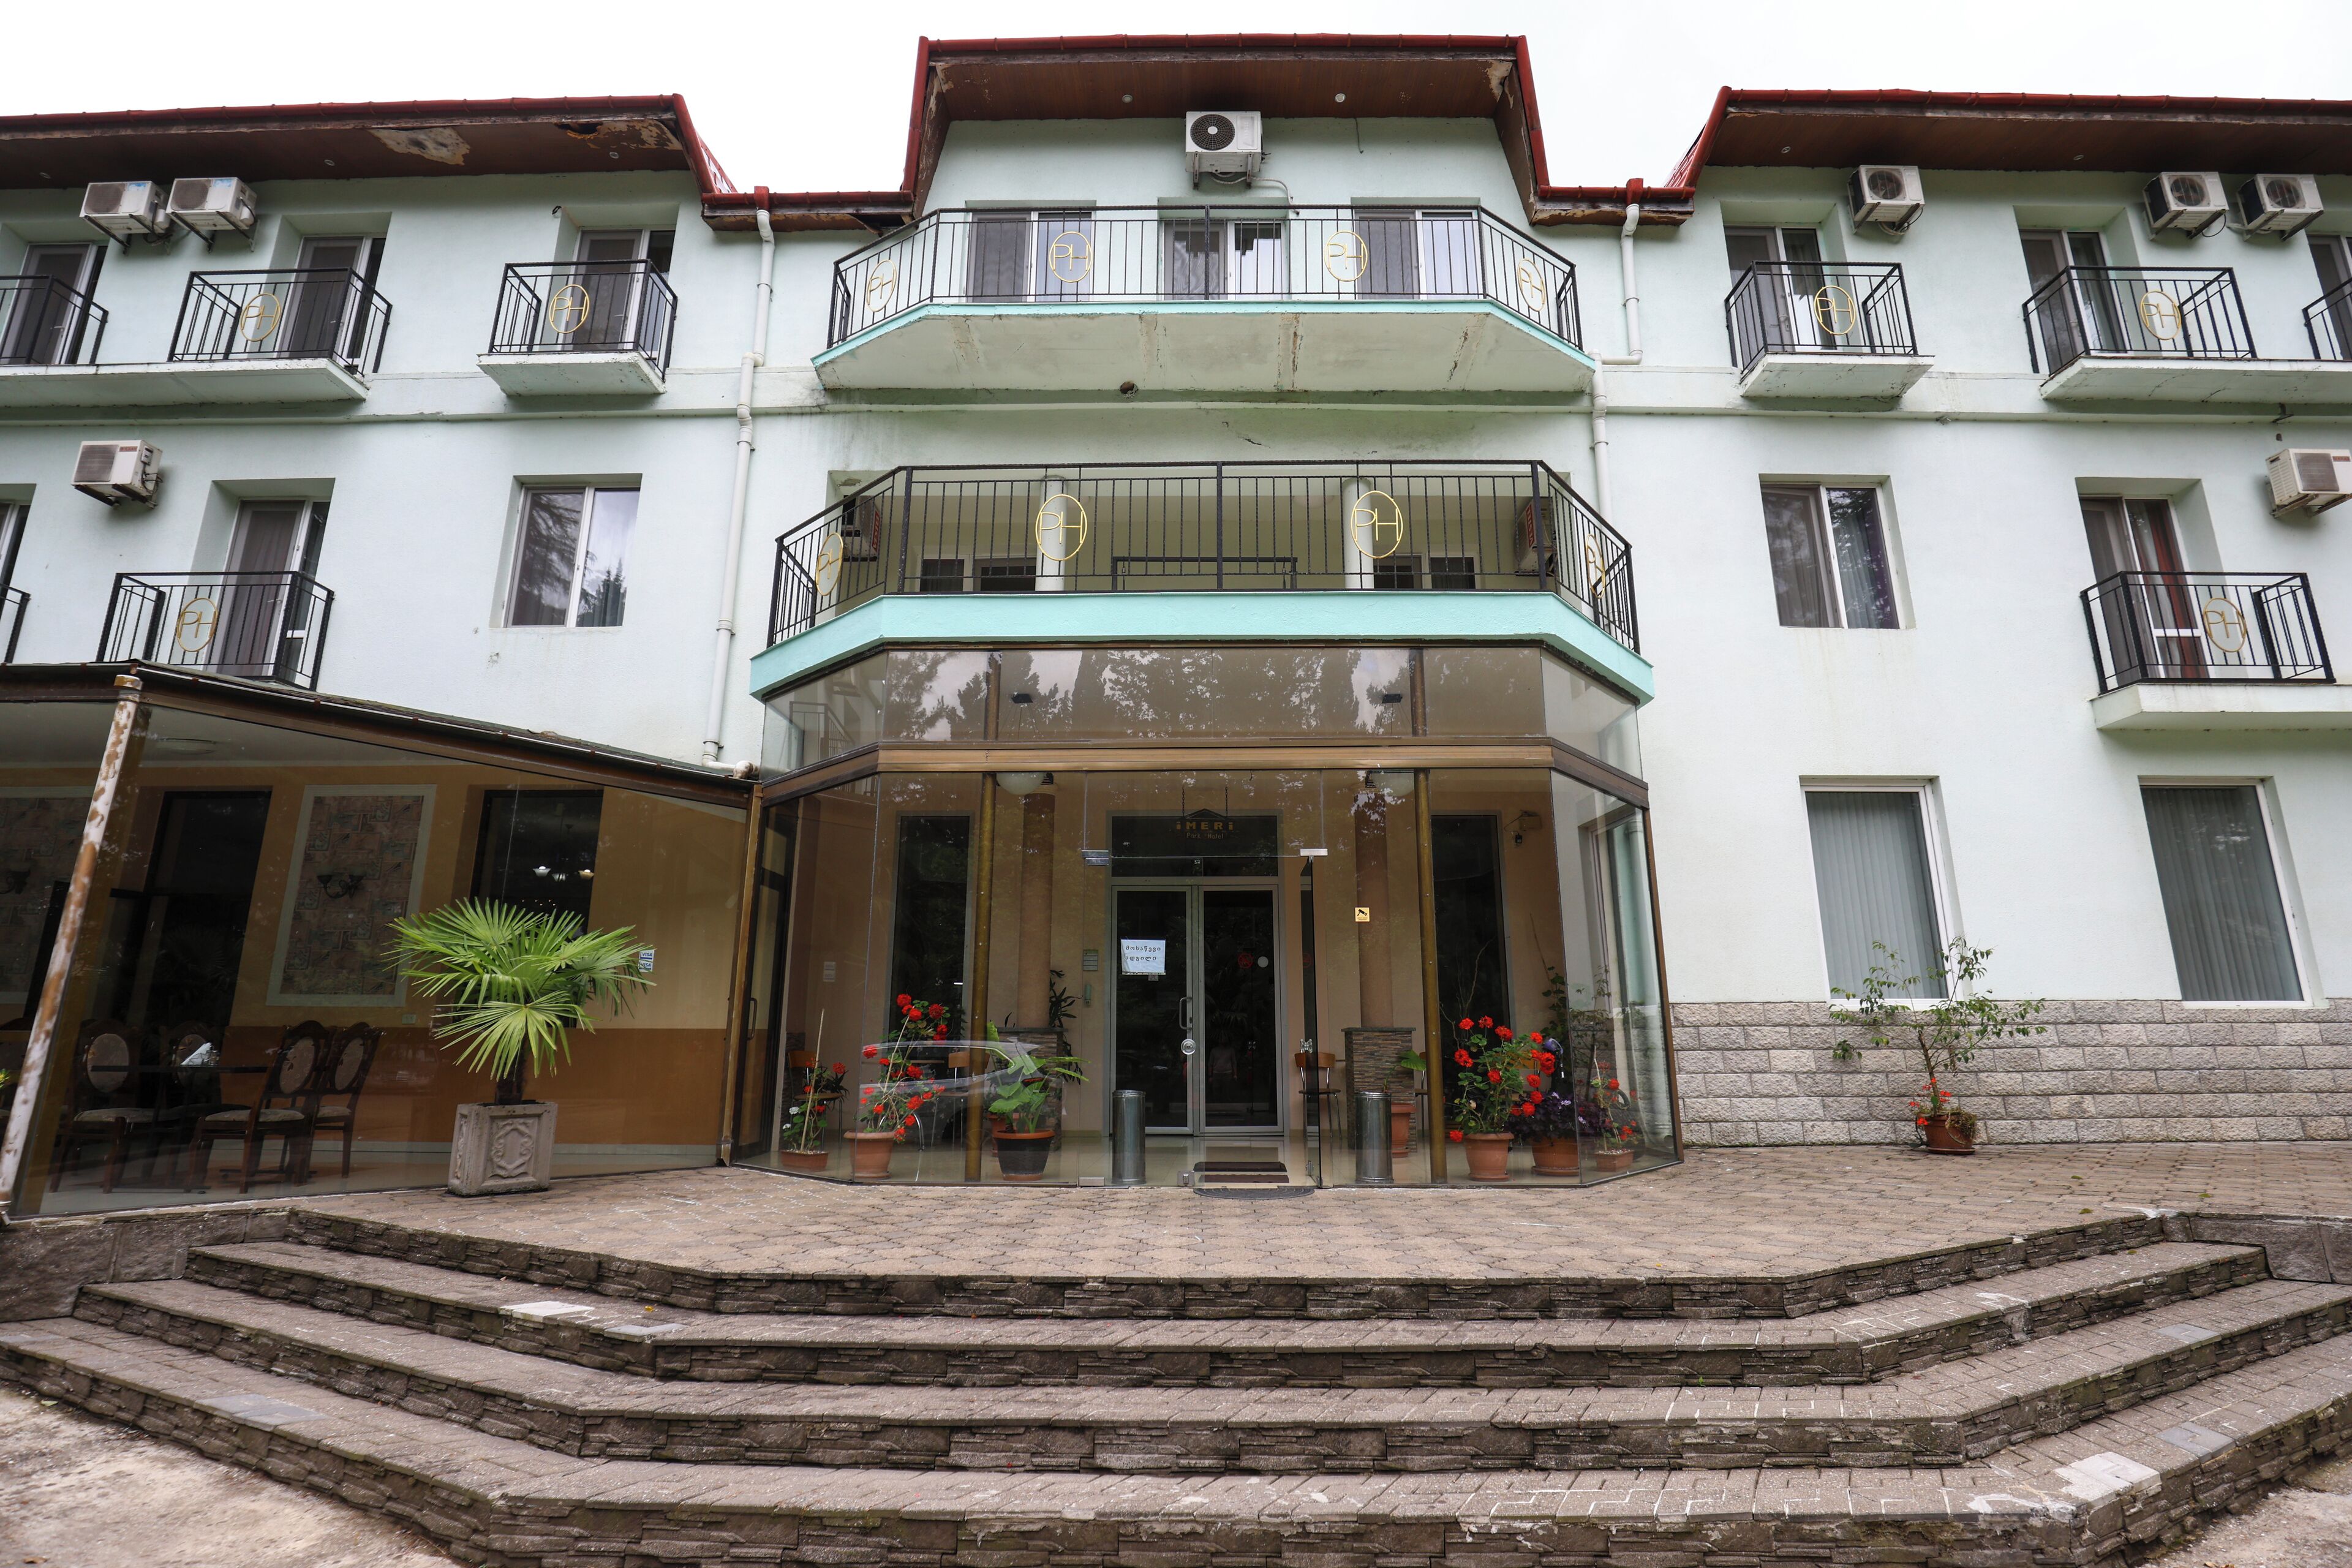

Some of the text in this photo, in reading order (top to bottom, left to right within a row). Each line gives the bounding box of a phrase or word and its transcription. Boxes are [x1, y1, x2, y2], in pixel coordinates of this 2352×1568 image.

[1053, 244, 1090, 271] PH
[1327, 243, 1365, 270] PH
[243, 306, 279, 330] PH
[551, 296, 589, 323] PH
[1817, 298, 1853, 324] PH
[2143, 303, 2180, 328] PH
[1039, 511, 1086, 545] PH
[1354, 508, 1401, 542] PH
[178, 611, 217, 638] PH
[2206, 611, 2246, 639] PH
